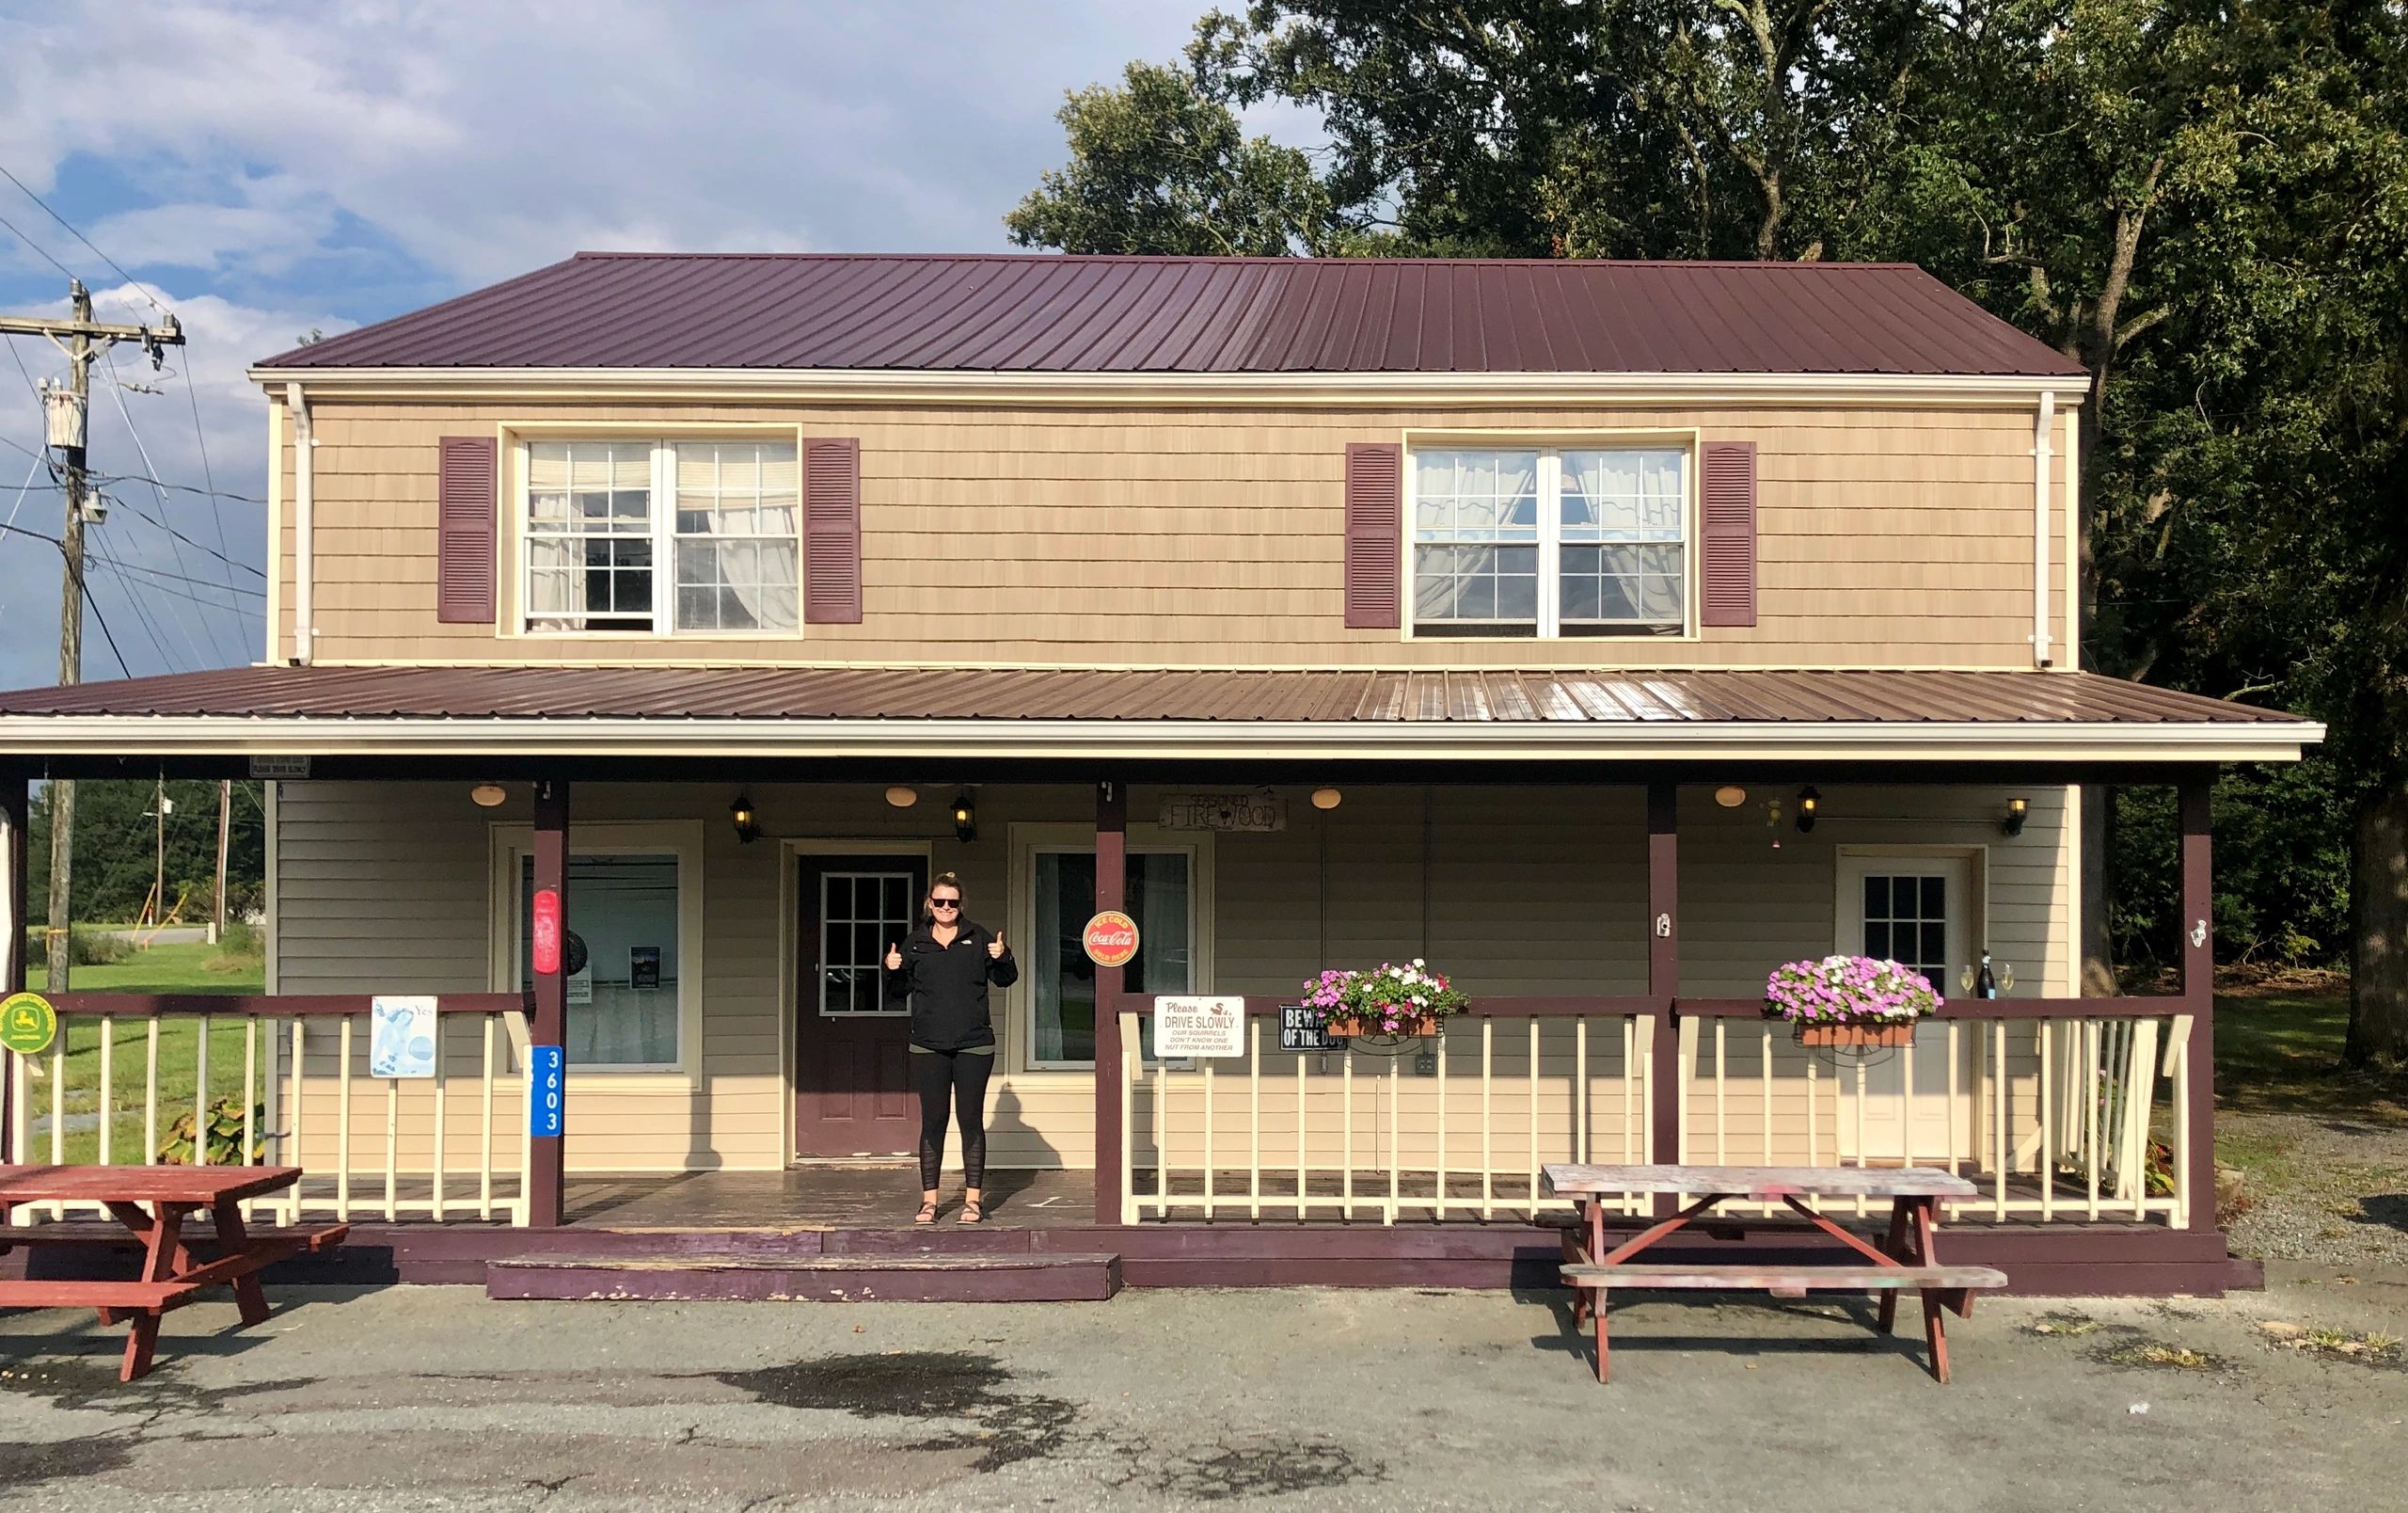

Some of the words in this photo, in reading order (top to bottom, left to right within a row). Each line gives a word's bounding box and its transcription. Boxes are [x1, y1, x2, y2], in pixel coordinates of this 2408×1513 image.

[1169, 804, 1275, 827] FIREWOOD
[1095, 917, 1107, 928] ICE
[1109, 916, 1128, 929] COLD
[1088, 932, 1133, 945] Coca-Cola
[415, 1005, 433, 1015] Yes
[1166, 1002, 1198, 1013] Please
[1164, 1016, 1193, 1028] DRIVE
[1196, 1016, 1235, 1028] SLOWLY
[1283, 1028, 1297, 1046] OF
[1299, 1028, 1320, 1046] THE
[547, 1051, 559, 1130] 3603
